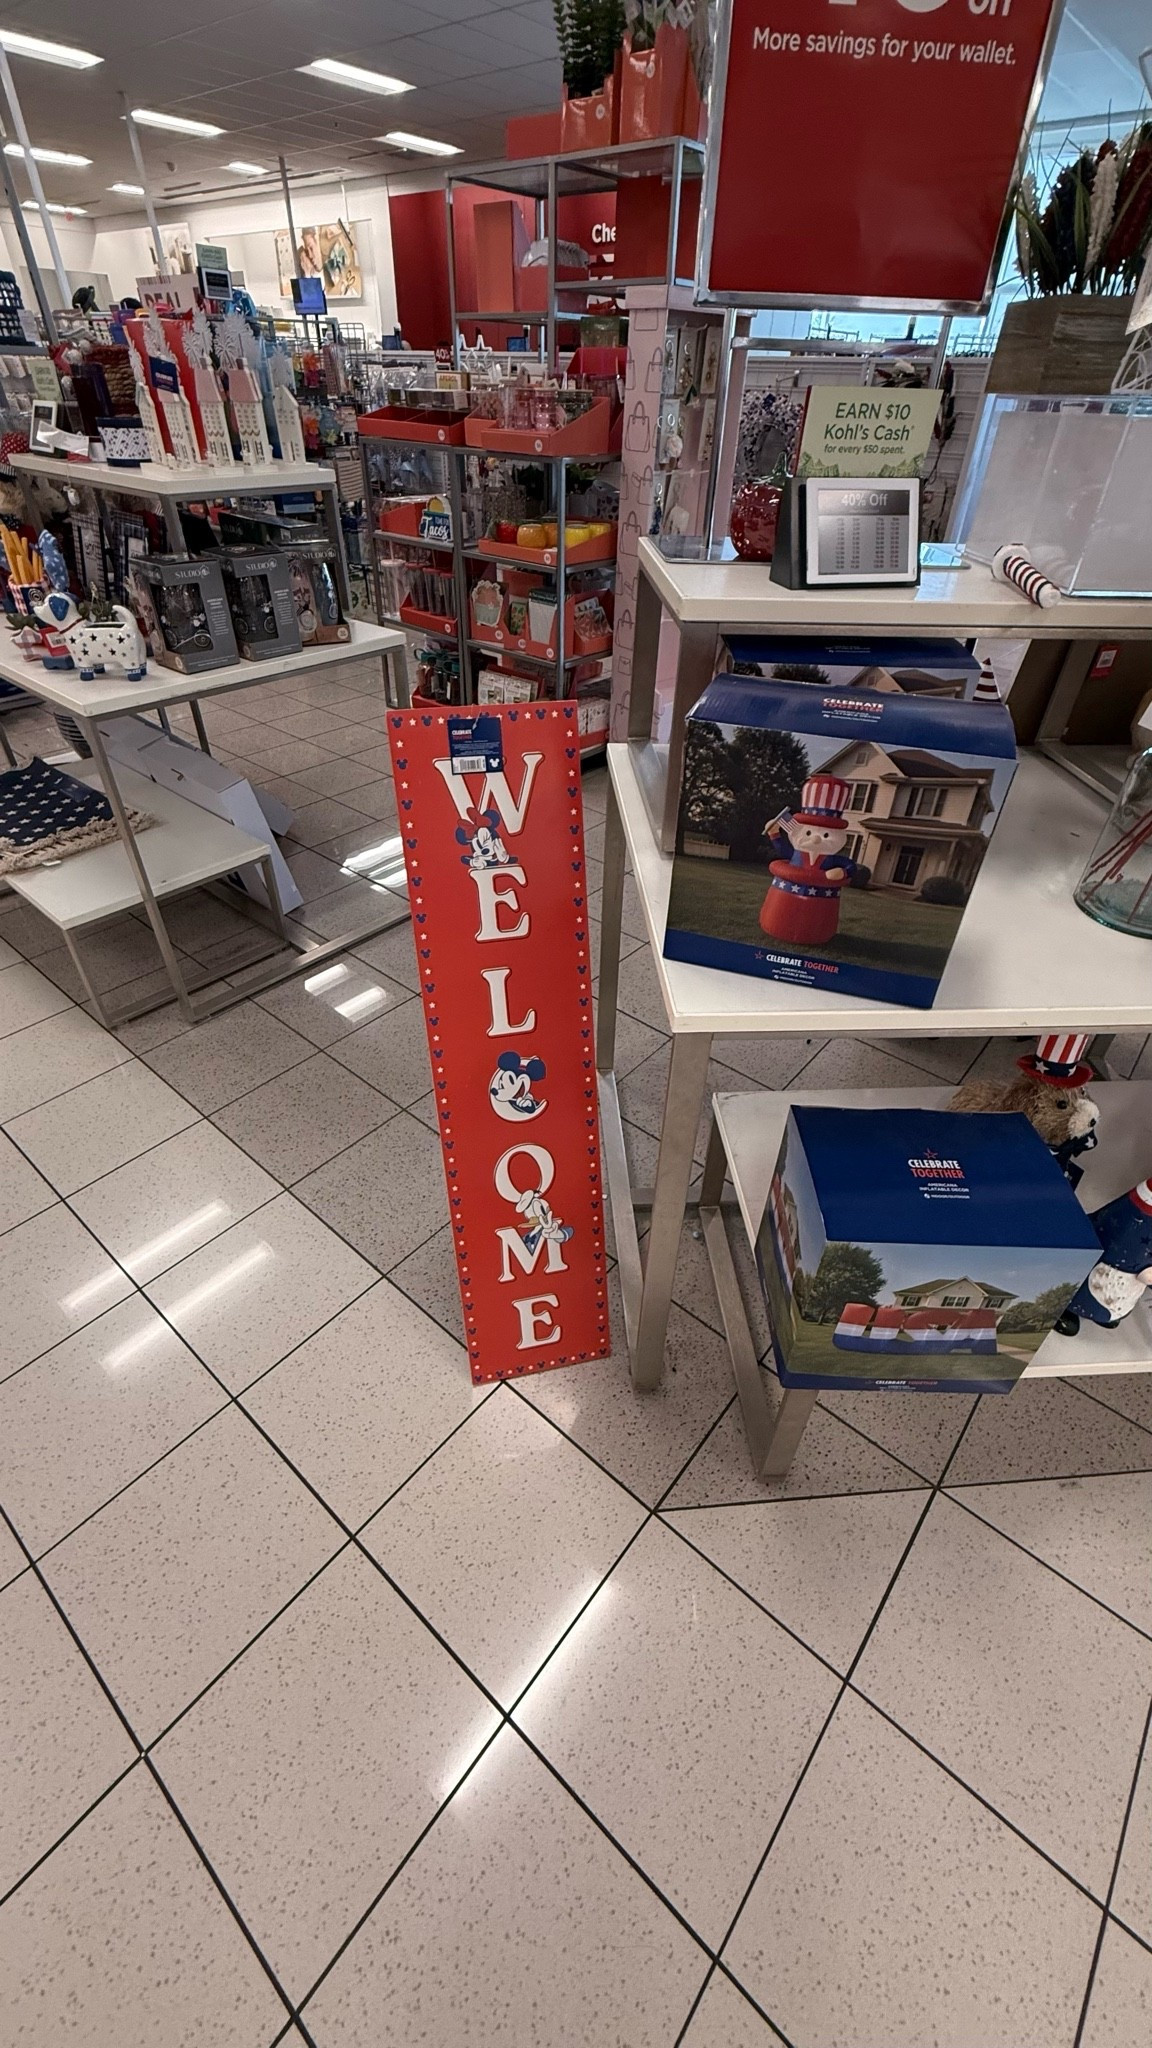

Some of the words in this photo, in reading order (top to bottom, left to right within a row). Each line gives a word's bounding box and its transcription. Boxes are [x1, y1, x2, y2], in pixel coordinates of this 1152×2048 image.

[753, 27, 801, 51] More
[806, 30, 876, 59] savings
[881, 32, 907, 57] for
[911, 41, 955, 63] your
[960, 40, 1016, 65] wallet.
[835, 402, 882, 419] EARN
[885, 403, 911, 420] $10
[824, 423, 870, 440] Kohl's
[824, 443, 837, 453] for
[838, 445, 861, 455] every
[863, 444, 879, 454] $50
[880, 446, 906, 455] spent.
[841, 493, 867, 507] 40%
[869, 493, 888, 506] Off
[422, 516, 449, 540] Tacos
[245, 562, 271, 571] STUDIO
[174, 569, 201, 579] STUDIO
[823, 697, 884, 708] CELEBRATE
[765, 954, 802, 967] CELEBRATE
[803, 960, 839, 974] TOGETHER
[908, 1159, 961, 1169] CELEBRATE
[910, 1168, 965, 1179] TOGETHER
